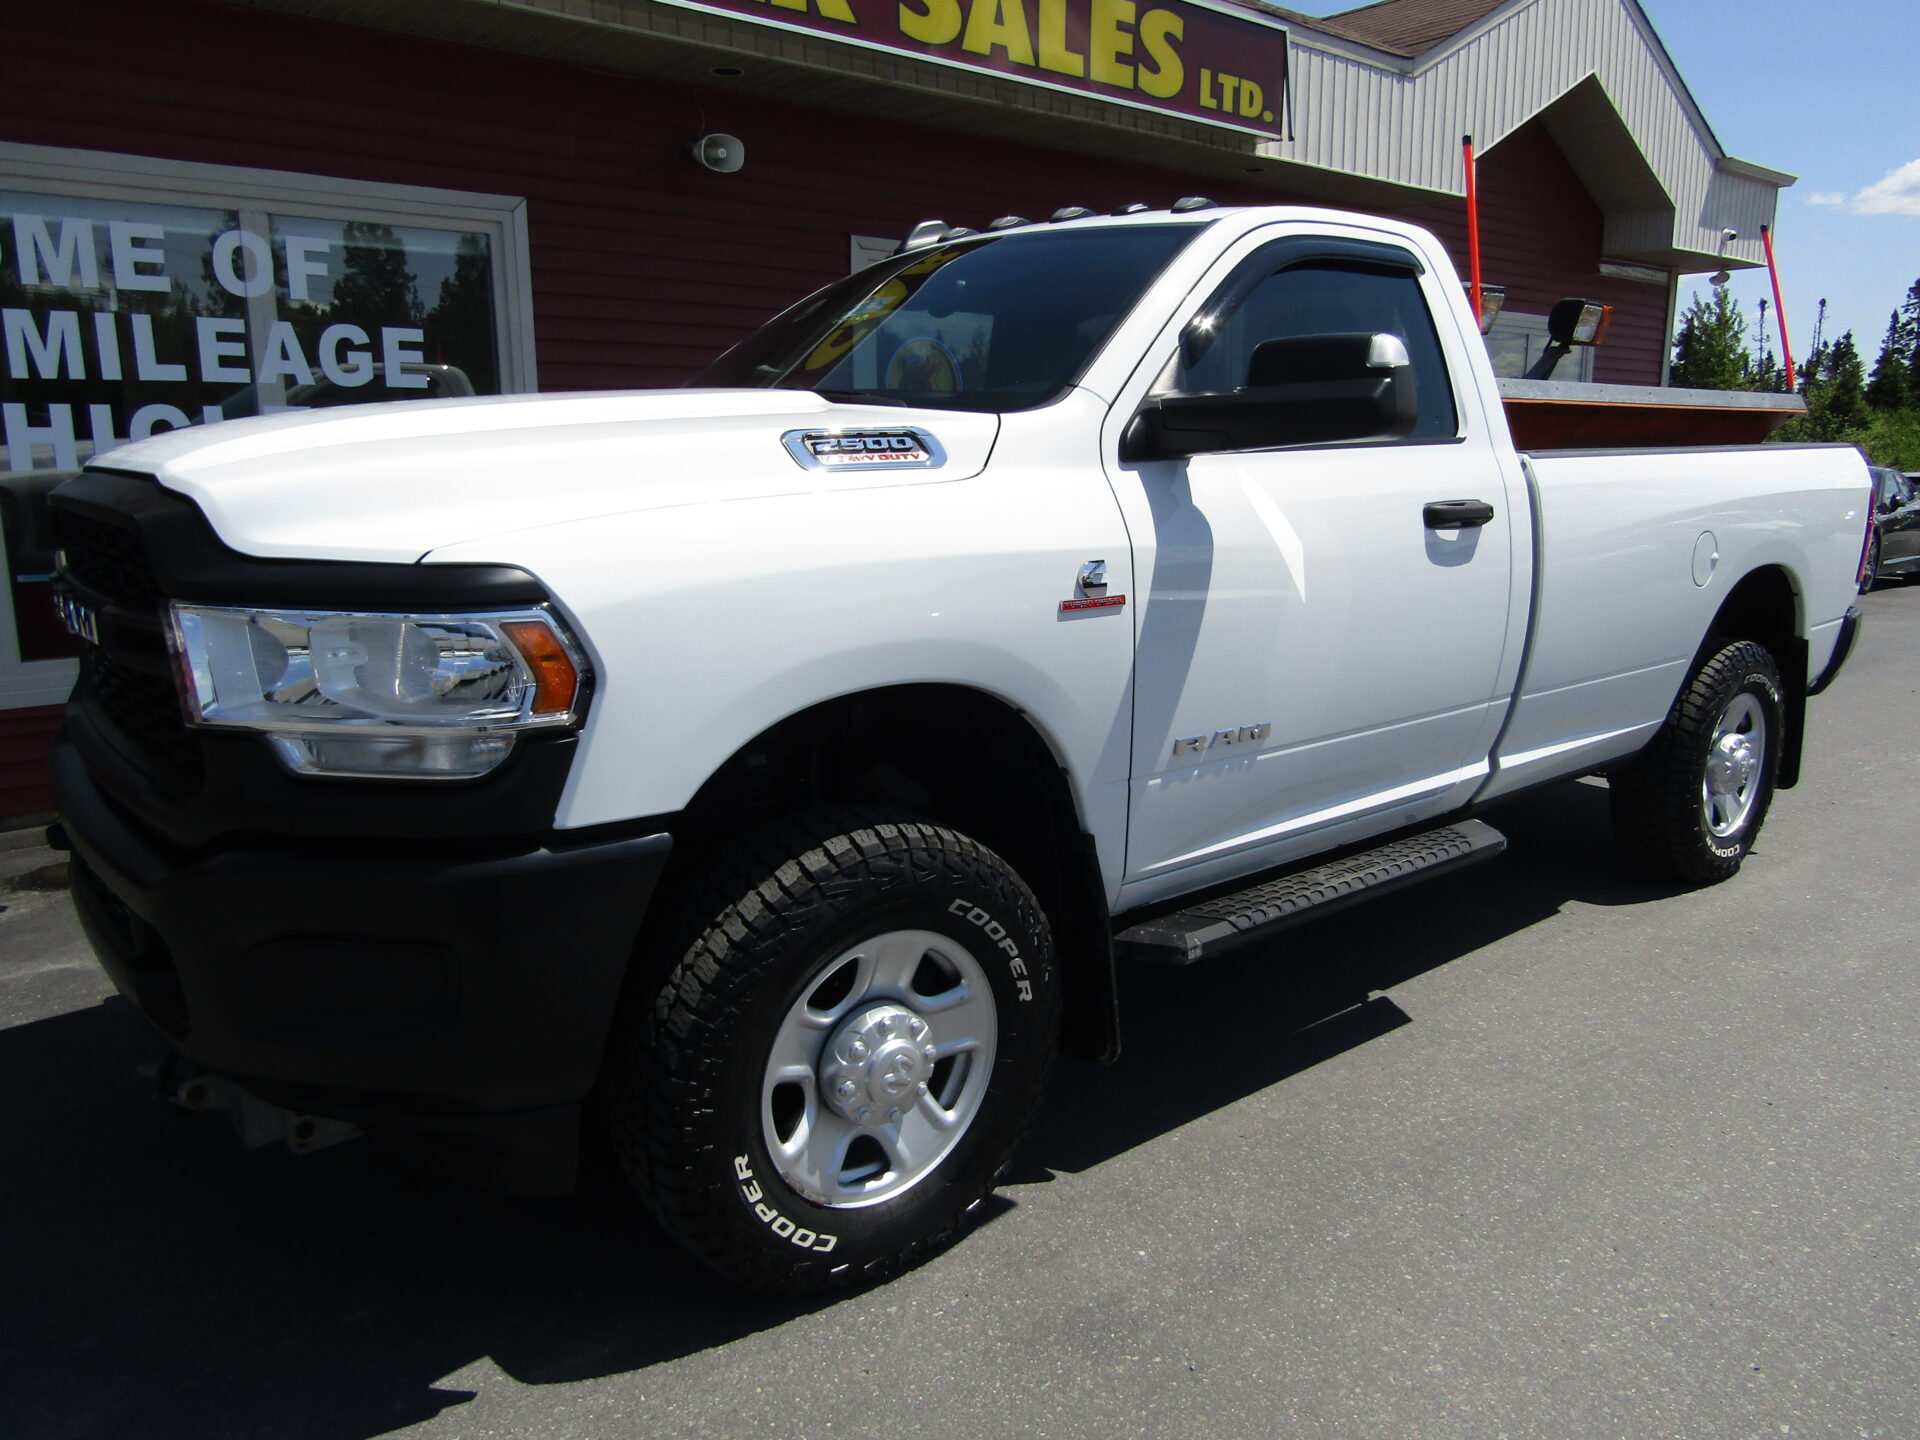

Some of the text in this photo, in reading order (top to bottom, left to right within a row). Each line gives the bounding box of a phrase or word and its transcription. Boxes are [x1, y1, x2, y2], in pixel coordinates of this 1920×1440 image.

[899, 0, 1274, 124] SALES LTD.
[0, 213, 330, 300] ME OF
[2, 308, 429, 388] MILEAGE
[811, 436, 914, 454] 2500
[877, 452, 920, 461] DUTY
[1174, 721, 1272, 756] RAM
[948, 898, 1033, 1002] COOPER
[734, 1153, 838, 1253] COOPER
